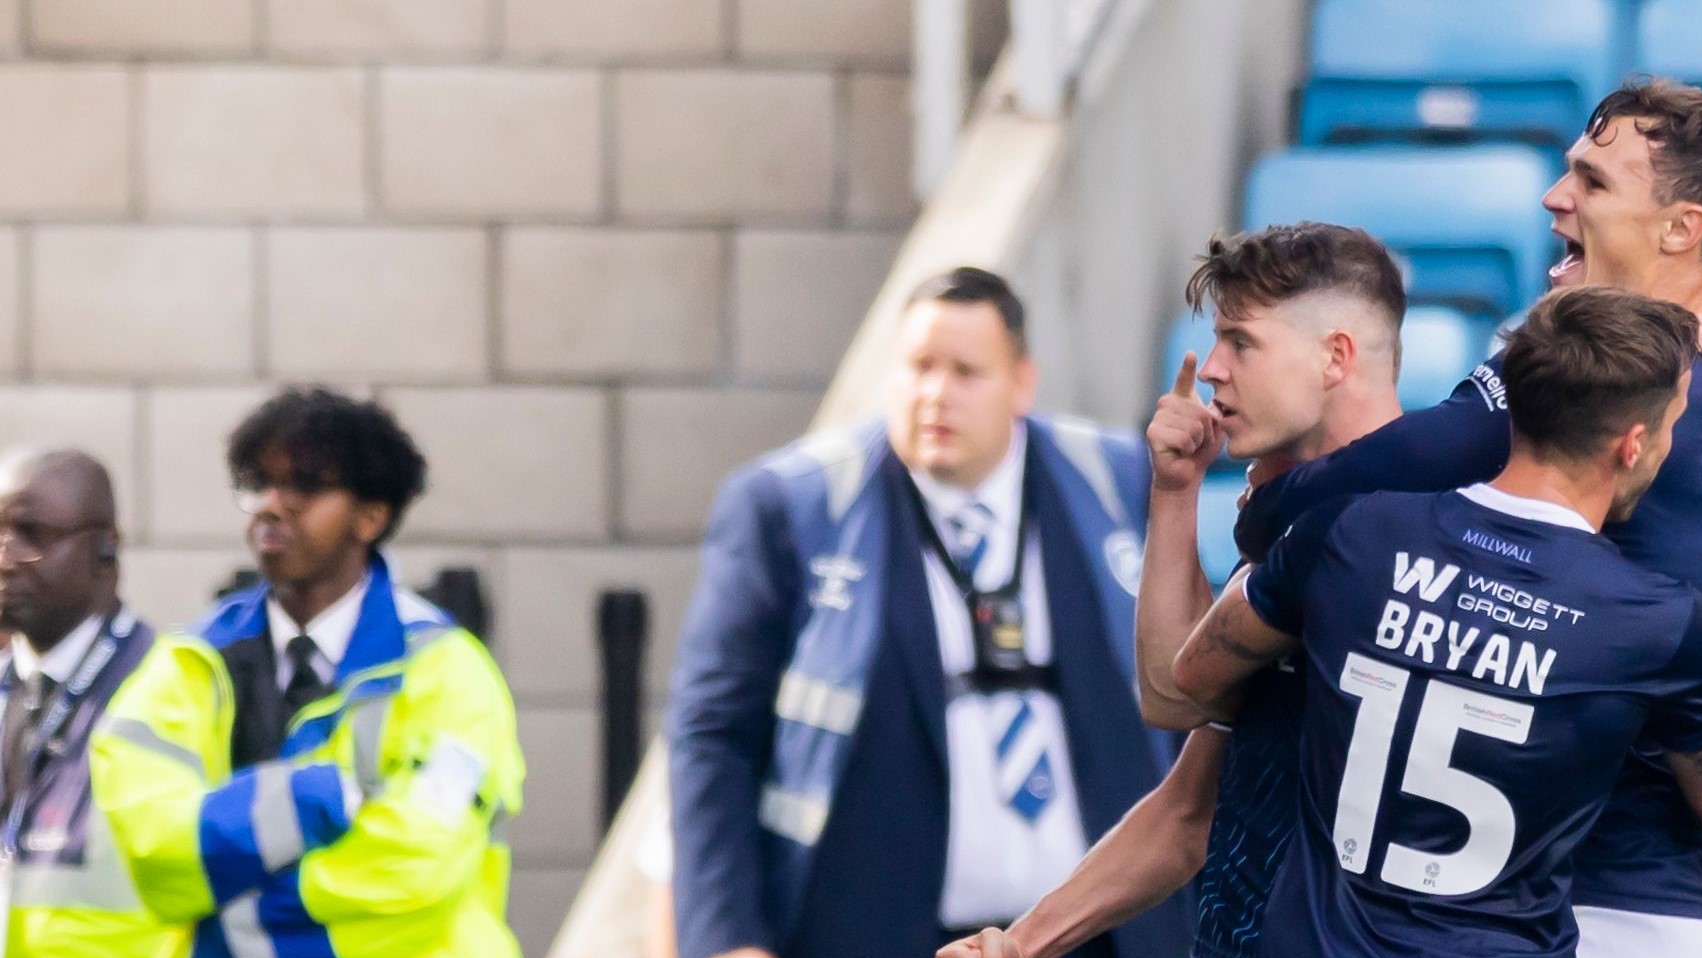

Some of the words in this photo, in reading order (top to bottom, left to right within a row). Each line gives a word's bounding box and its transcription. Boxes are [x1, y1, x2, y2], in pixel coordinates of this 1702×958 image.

[1462, 529, 1532, 564] MILLWALL
[1393, 551, 1461, 603] W
[1468, 574, 1586, 625] WIGGETT
[1457, 593, 1548, 631] GROUP
[1375, 599, 1558, 695] BRYAN
[1332, 652, 1536, 896] 15
